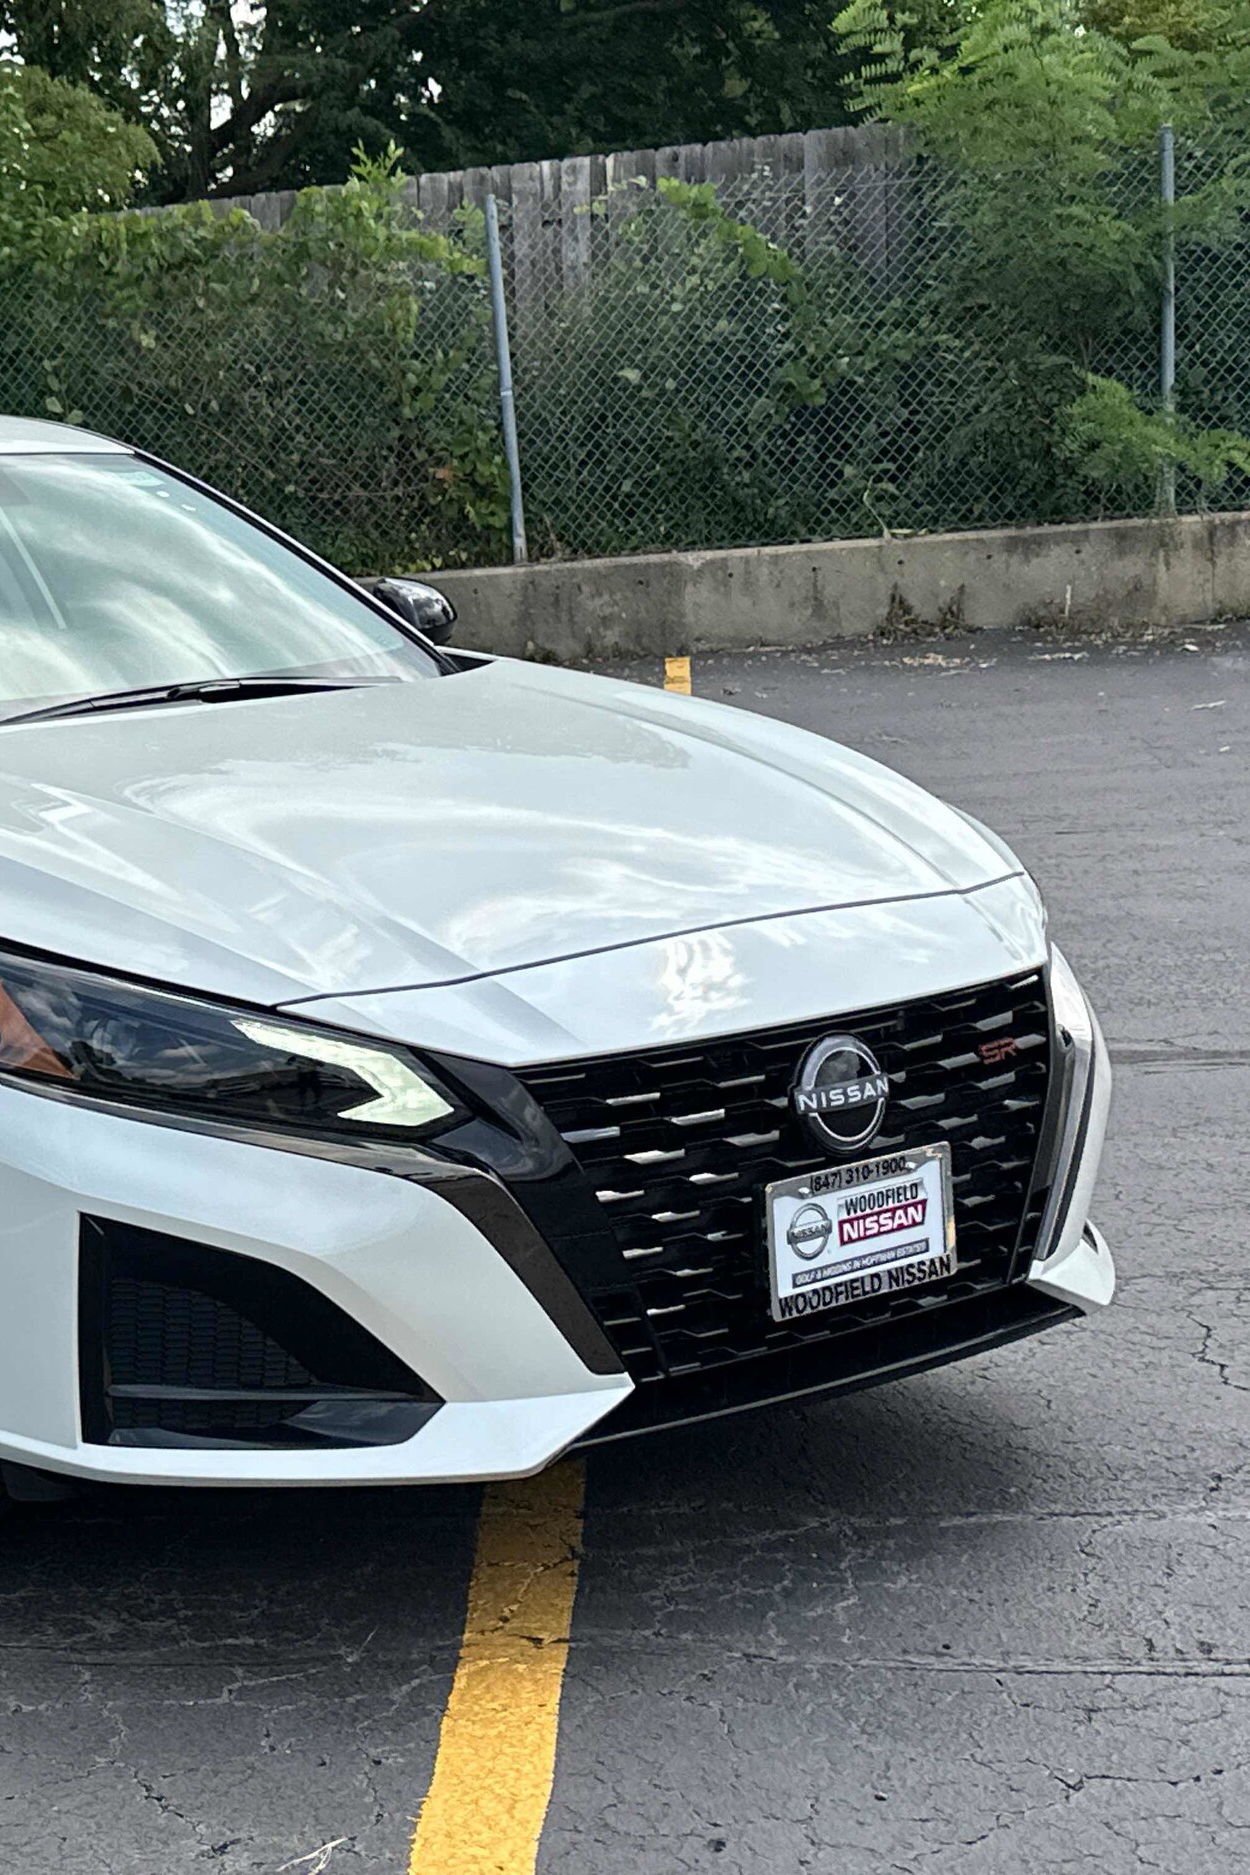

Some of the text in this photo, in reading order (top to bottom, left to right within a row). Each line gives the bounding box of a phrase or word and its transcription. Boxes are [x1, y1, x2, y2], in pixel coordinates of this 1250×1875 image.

[979, 1037, 1017, 1064] SR
[799, 1077, 889, 1111] NISSAN
[811, 1156, 906, 1194] (847) 310-1900
[845, 1183, 919, 1216] WOODFIELD
[791, 1223, 827, 1239] NISSAN
[842, 1204, 924, 1242] NISSAN
[778, 1253, 952, 1318] WOODFIELD NISSAN
